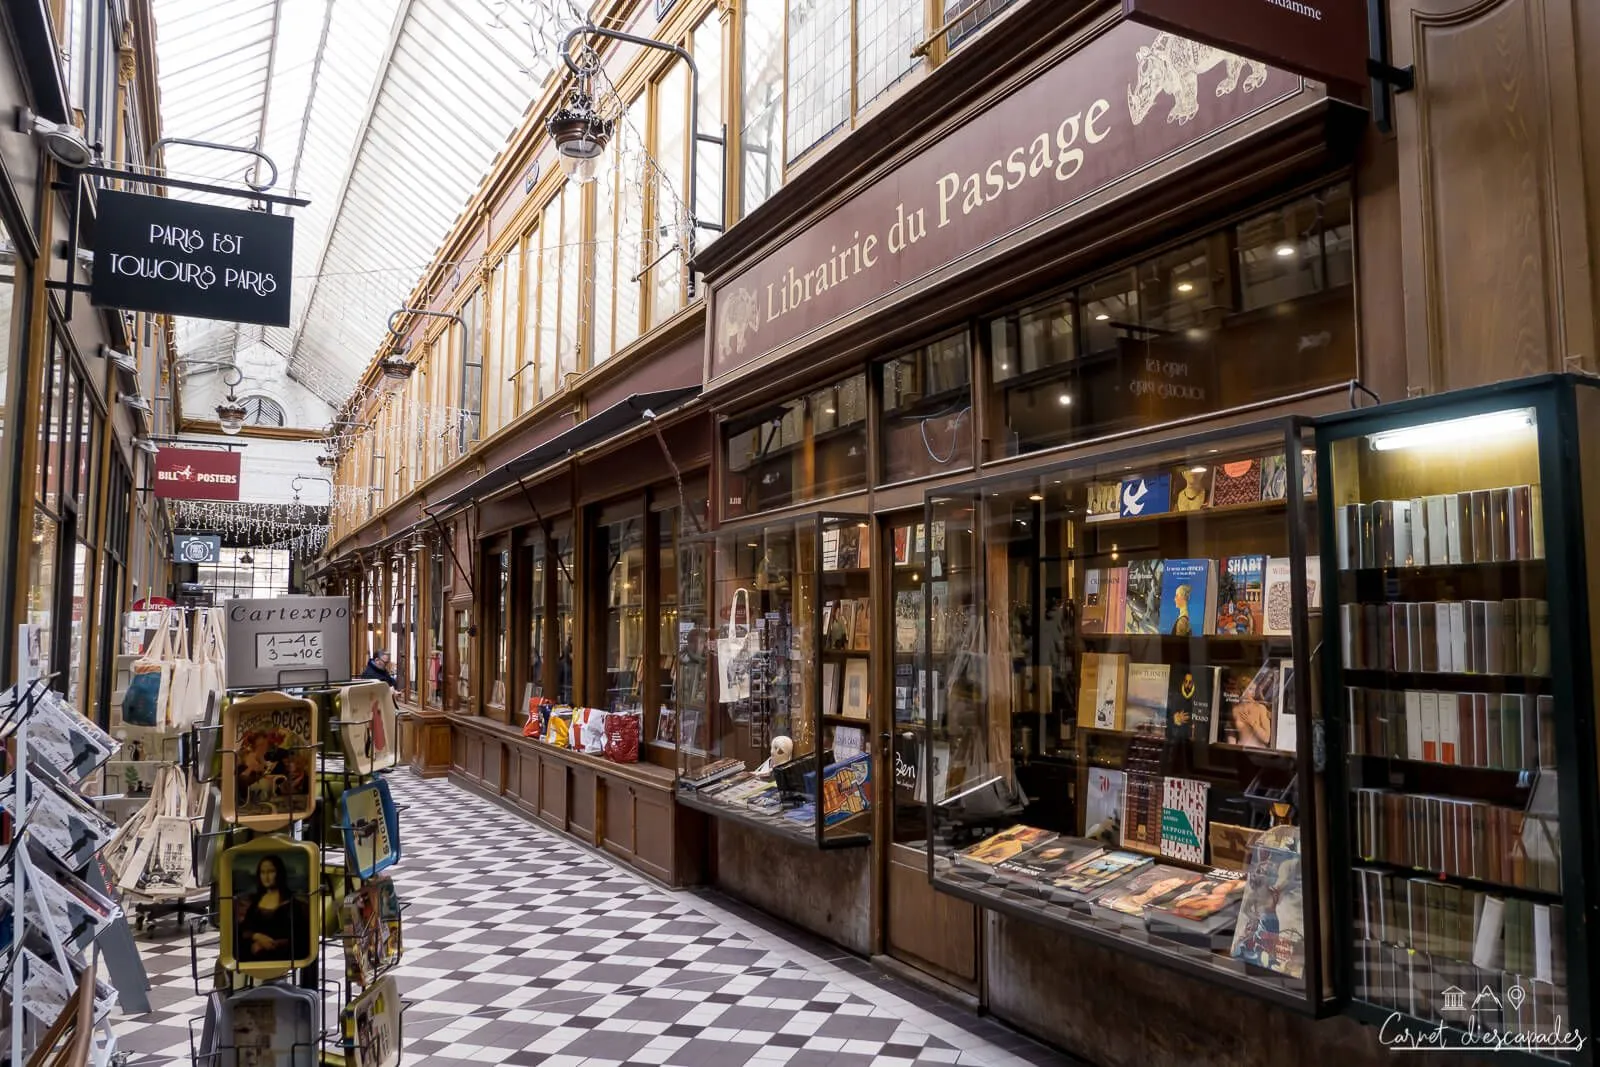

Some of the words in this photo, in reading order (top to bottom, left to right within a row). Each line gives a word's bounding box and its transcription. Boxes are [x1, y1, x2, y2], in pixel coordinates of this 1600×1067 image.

[764, 230, 879, 323] Librairie
[887, 203, 928, 254] du
[936, 98, 1112, 229] Passage
[150, 223, 204, 254] PARIS
[213, 232, 243, 255] EST
[110, 252, 217, 290] TOUJOURS
[225, 267, 277, 297] PARIS
[157, 470, 179, 481] BILL
[196, 472, 238, 484] POSTERS
[231, 605, 347, 623] Cartexpo
[268, 648, 278, 661] 3
